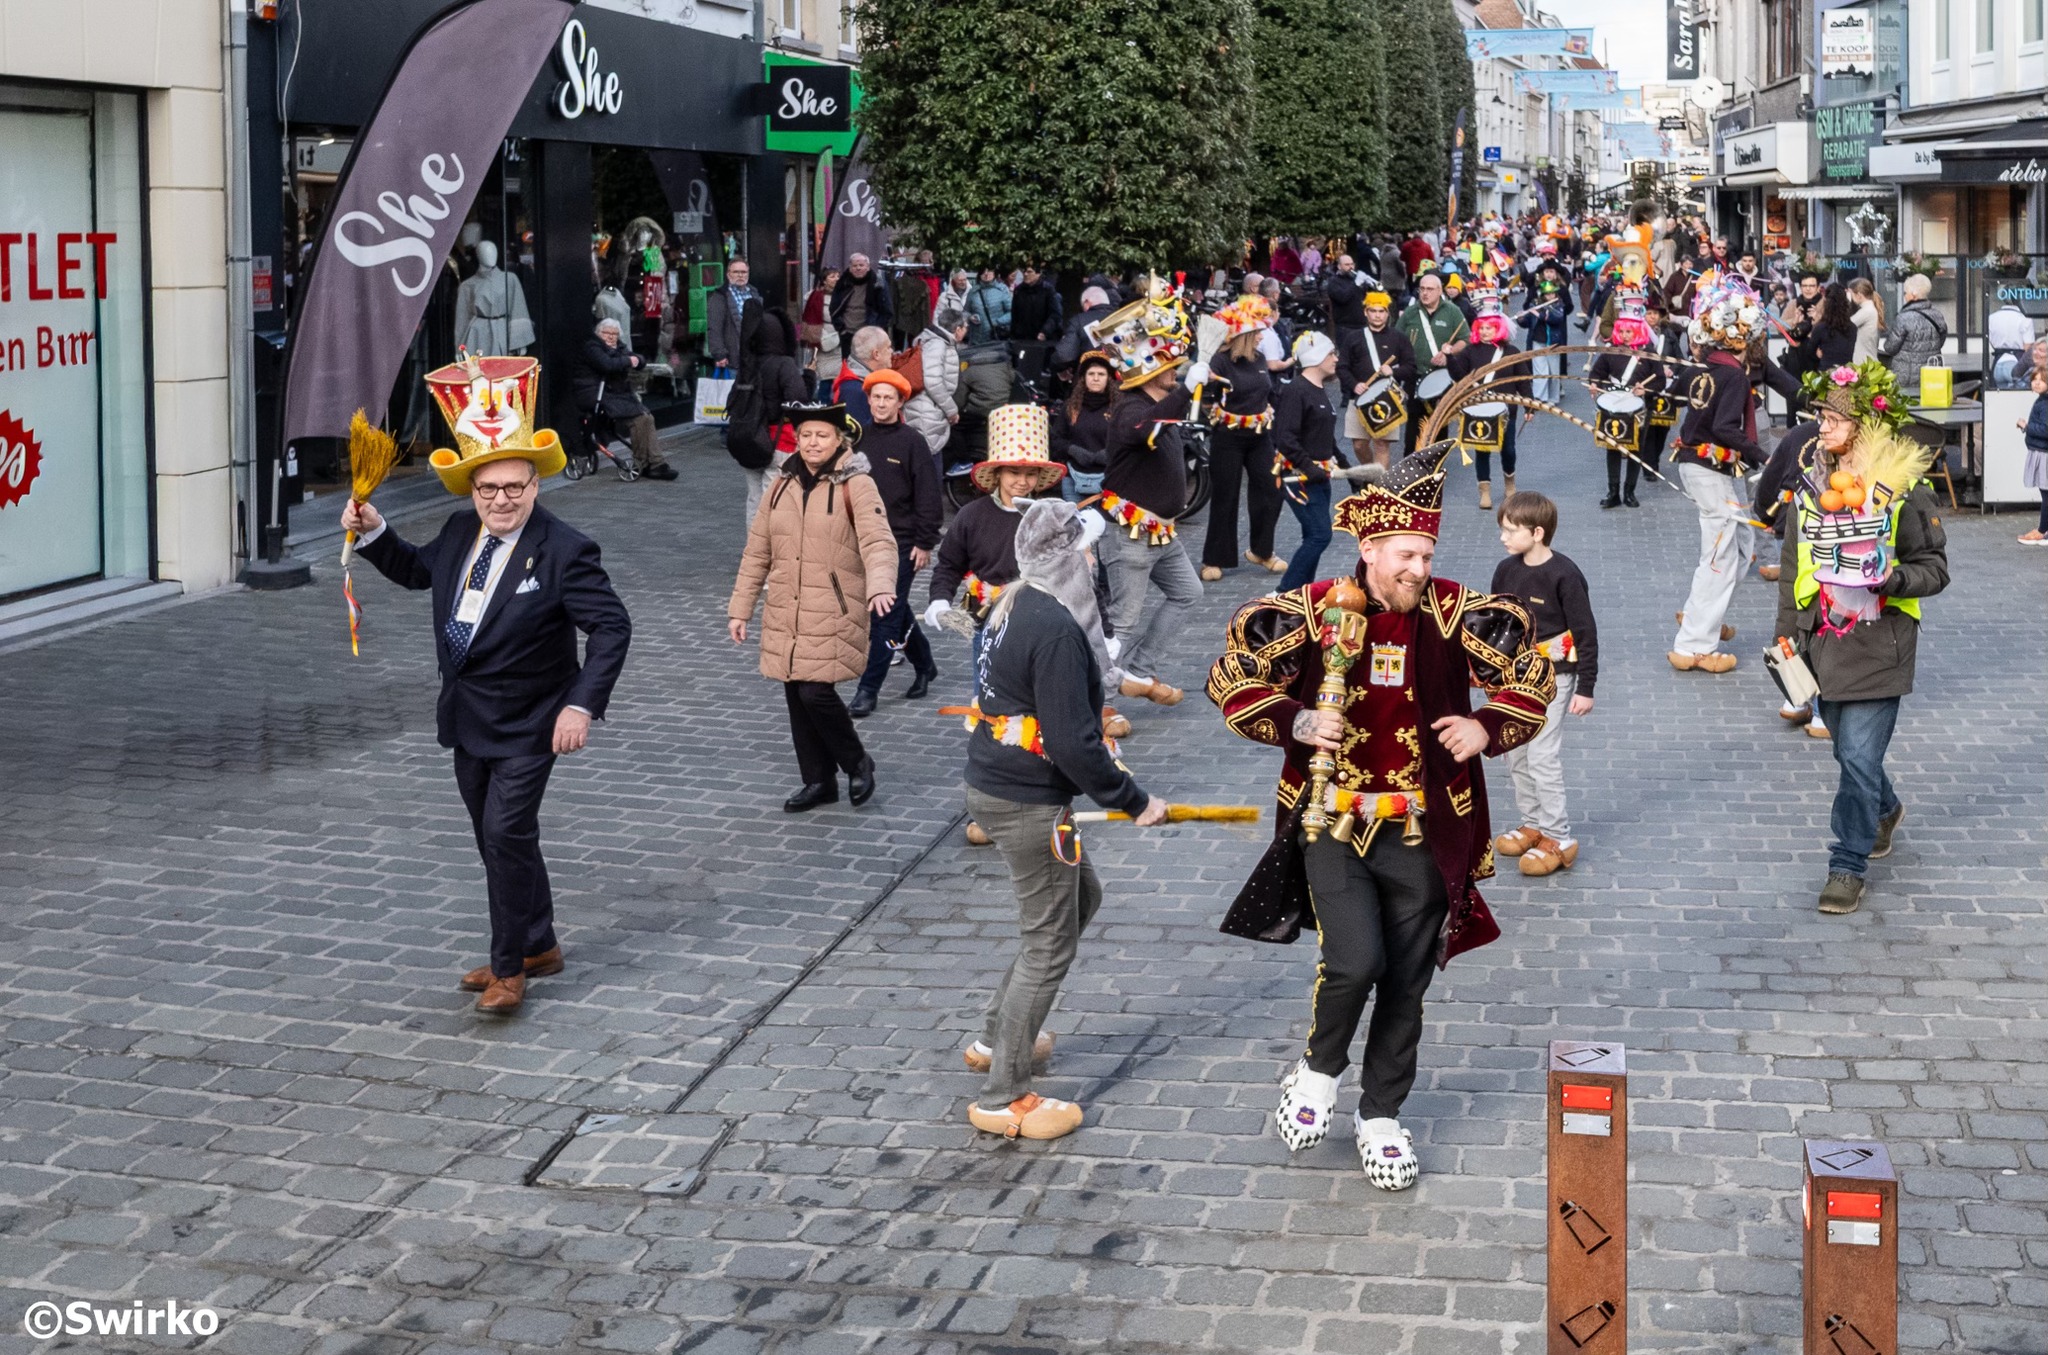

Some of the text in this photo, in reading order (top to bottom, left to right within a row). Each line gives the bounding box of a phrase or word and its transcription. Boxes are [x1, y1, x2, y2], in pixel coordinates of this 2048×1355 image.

[1825, 45, 1869, 53] TE KOOP
[559, 19, 623, 119] She
[778, 77, 838, 119] She
[1816, 108, 1834, 139] GSM
[1835, 107, 1841, 137] &
[1823, 140, 1866, 160] REPARATIE
[1997, 158, 2047, 182] atelier
[839, 178, 881, 226] Sh
[334, 152, 465, 297] She
[1997, 287, 2048, 300] ONTBIJT
